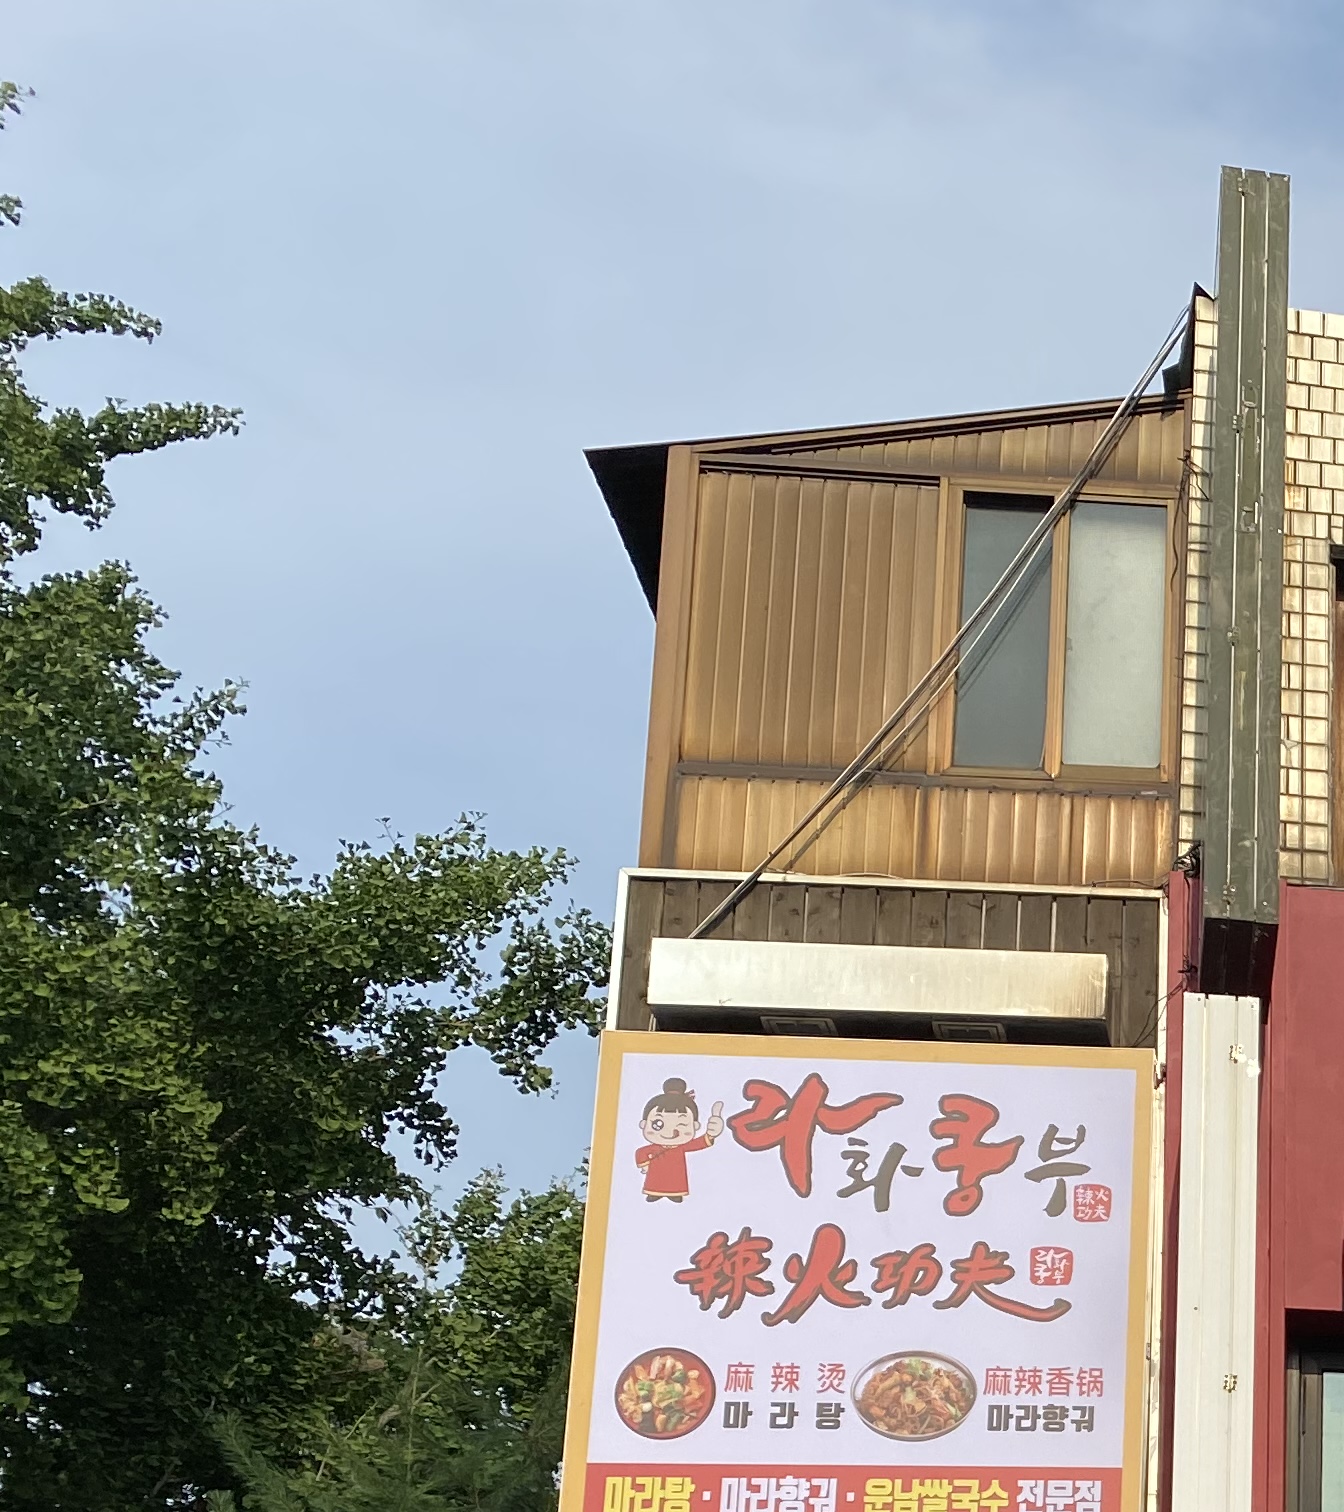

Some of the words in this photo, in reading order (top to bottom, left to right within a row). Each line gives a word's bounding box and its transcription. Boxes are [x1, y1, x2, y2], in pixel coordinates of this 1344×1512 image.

[727, 1073, 1091, 1217] 라화쿵부
[674, 1224, 1072, 1327] 辣火功夫
[724, 1361, 847, 1393] 麻辣烫
[983, 1366, 1105, 1399] 麻辣香锅
[722, 1401, 846, 1431] 마라탕
[986, 1403, 1096, 1433] 마라향궈
